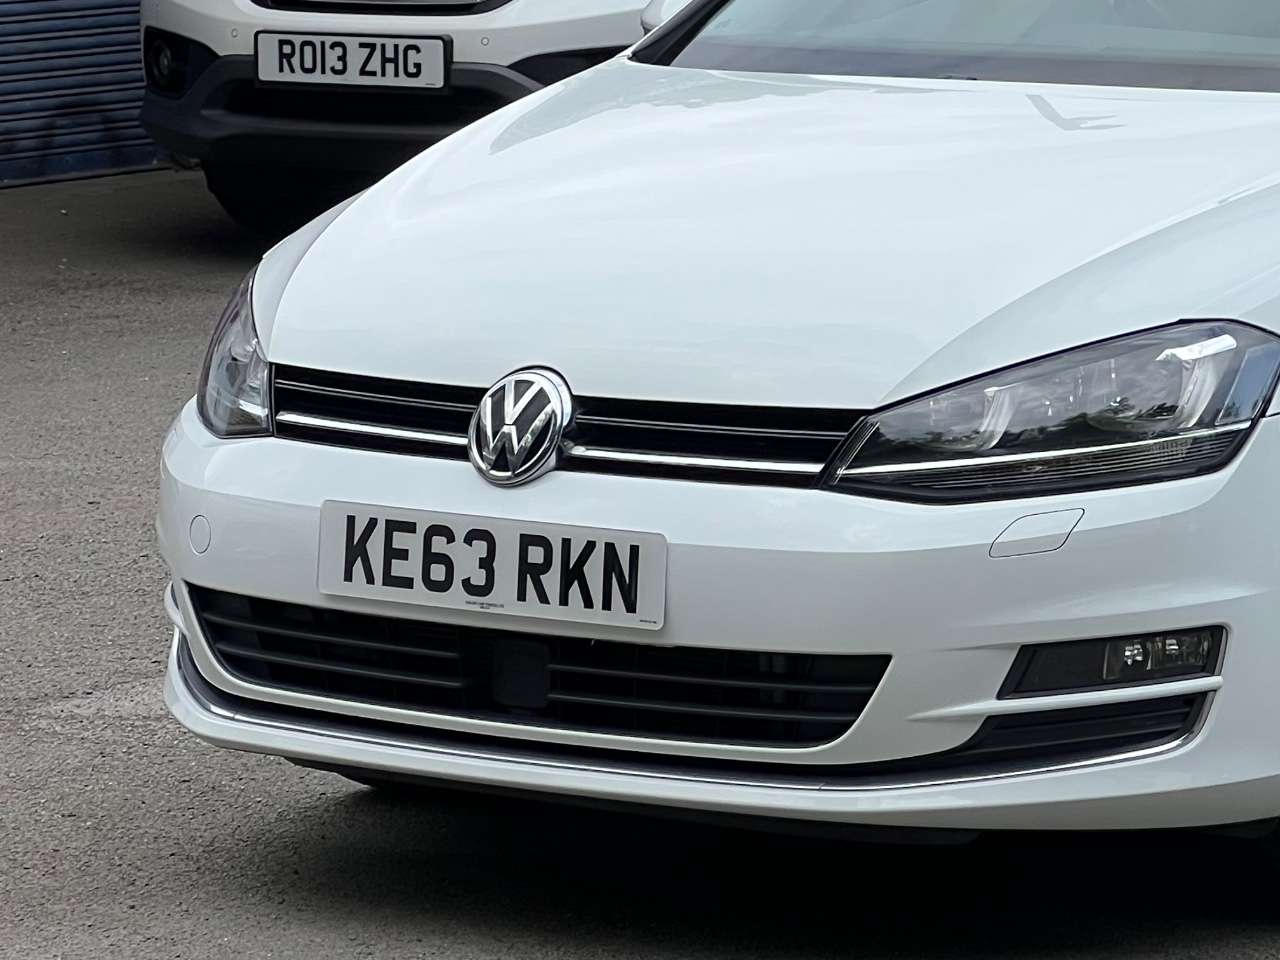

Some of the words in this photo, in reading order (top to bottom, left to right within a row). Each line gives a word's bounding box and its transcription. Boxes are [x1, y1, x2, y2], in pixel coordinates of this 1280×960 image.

[278, 38, 347, 75] RO13
[358, 42, 422, 78] ZHG
[343, 514, 497, 598] KE63
[516, 532, 640, 614] RKN
